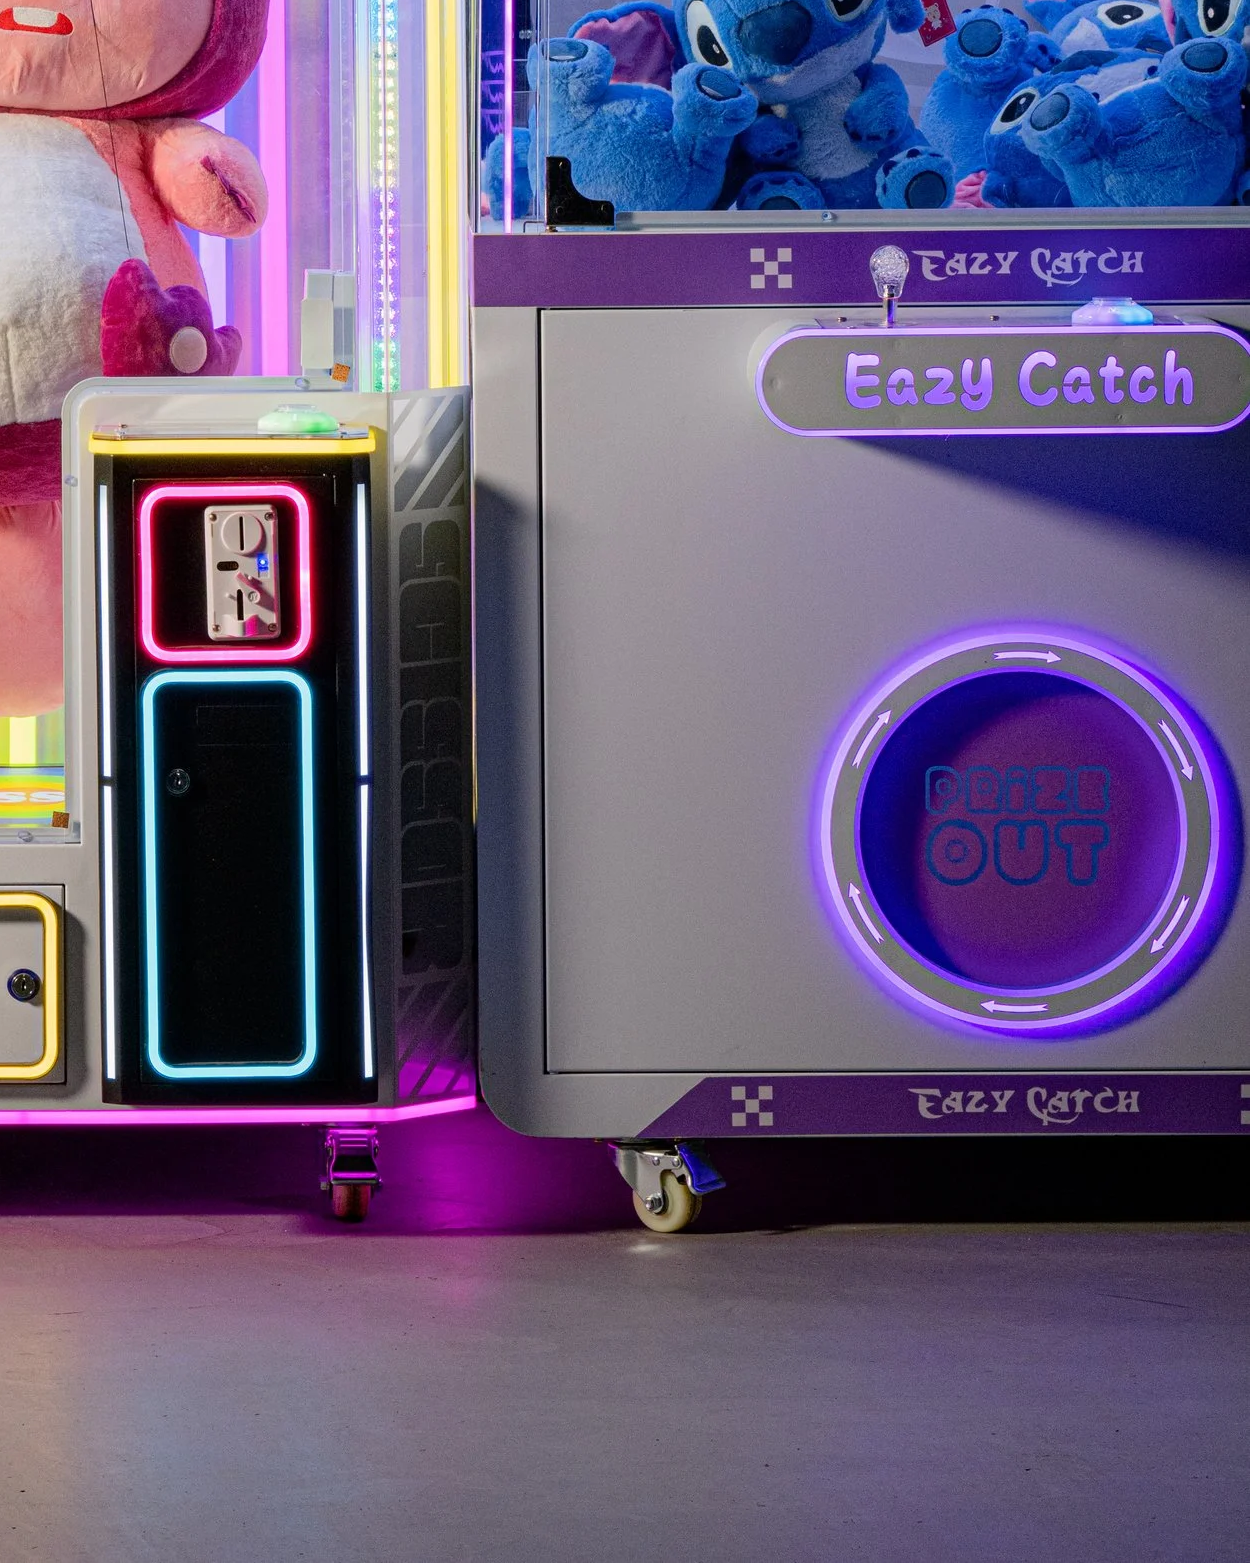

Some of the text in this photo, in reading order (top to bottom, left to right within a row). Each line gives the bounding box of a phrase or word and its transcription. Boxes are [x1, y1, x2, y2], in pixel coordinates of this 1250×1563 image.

[845, 349, 1194, 412] Eazy Catch
[925, 819, 1111, 886] OUT
